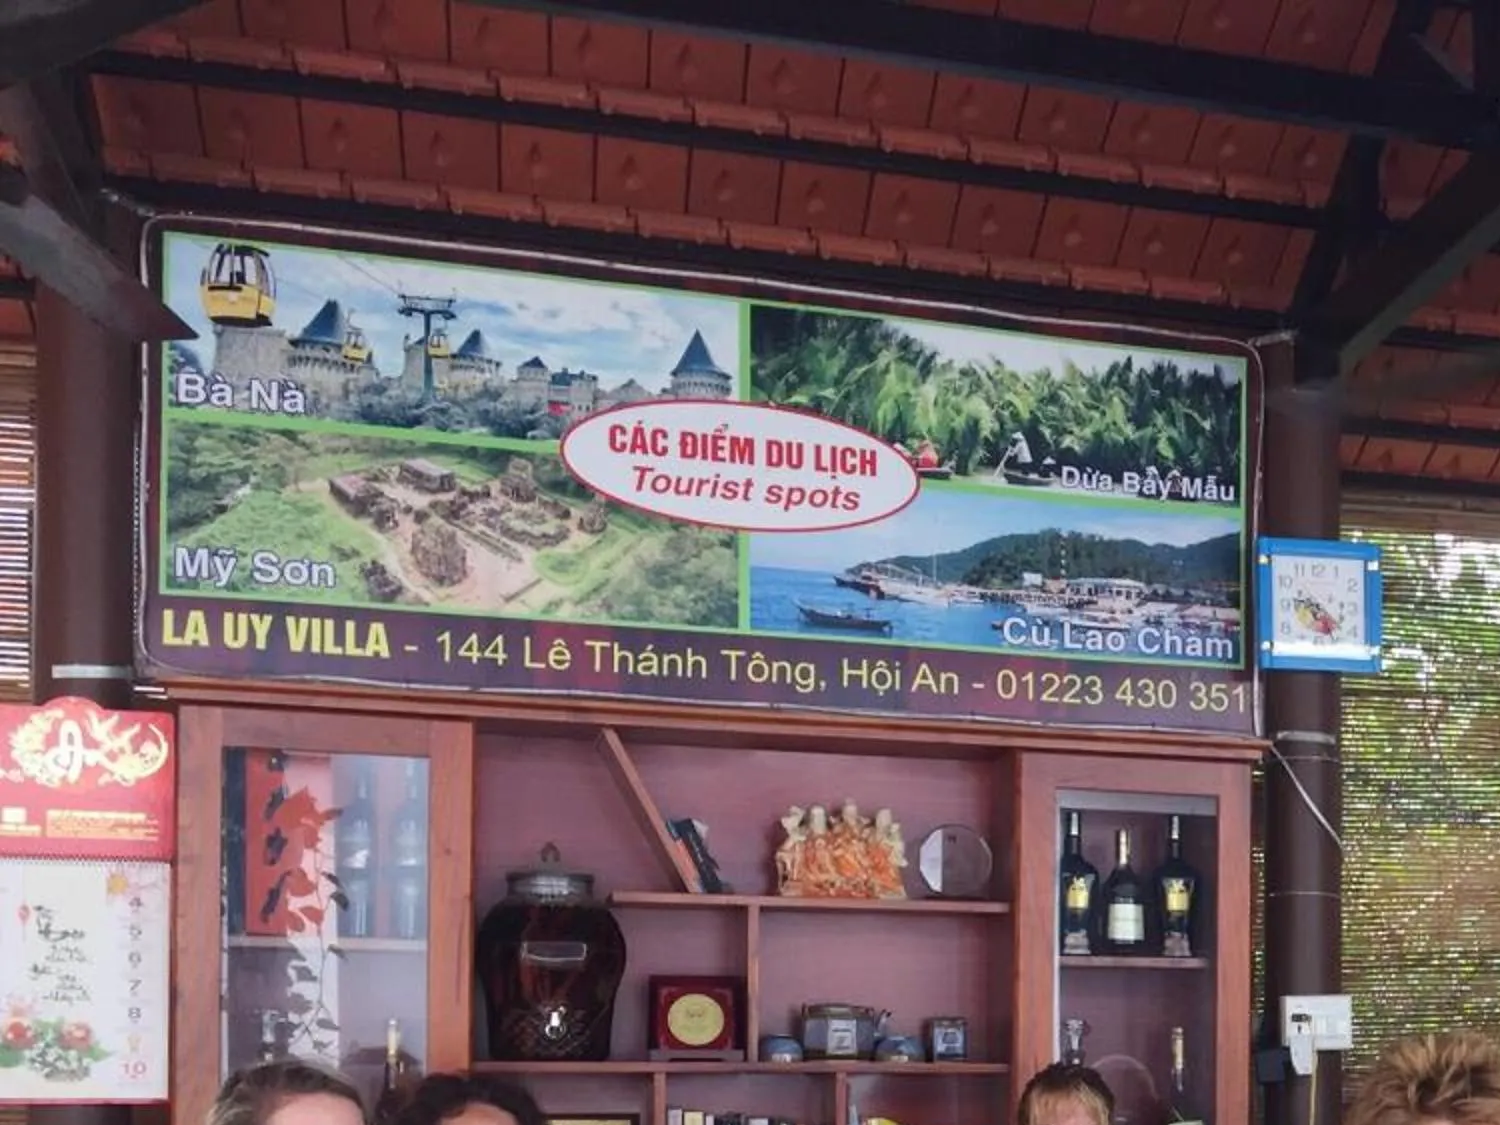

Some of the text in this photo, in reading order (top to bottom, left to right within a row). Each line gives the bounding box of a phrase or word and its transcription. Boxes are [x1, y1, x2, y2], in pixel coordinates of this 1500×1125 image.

[176, 373, 305, 413] Bà Nà
[608, 420, 878, 479] CÁC ĐIỂM DU LỊCH
[632, 465, 861, 512] Tourist spots
[174, 547, 336, 587] Mỹ Sơn
[1003, 617, 1233, 659] Cù Lao Chàm
[162, 609, 210, 647] LA
[223, 612, 273, 650] UY
[285, 615, 391, 659] VILLA
[436, 630, 508, 667] 144
[523, 636, 573, 672] Lê
[584, 640, 708, 680] Thánh
[720, 649, 827, 693] Tông,
[841, 658, 901, 697] Hội
[911, 661, 959, 695] An
[996, 668, 1104, 705] 01223
[1115, 677, 1178, 709] 430
[1188, 681, 1248, 714] 351
